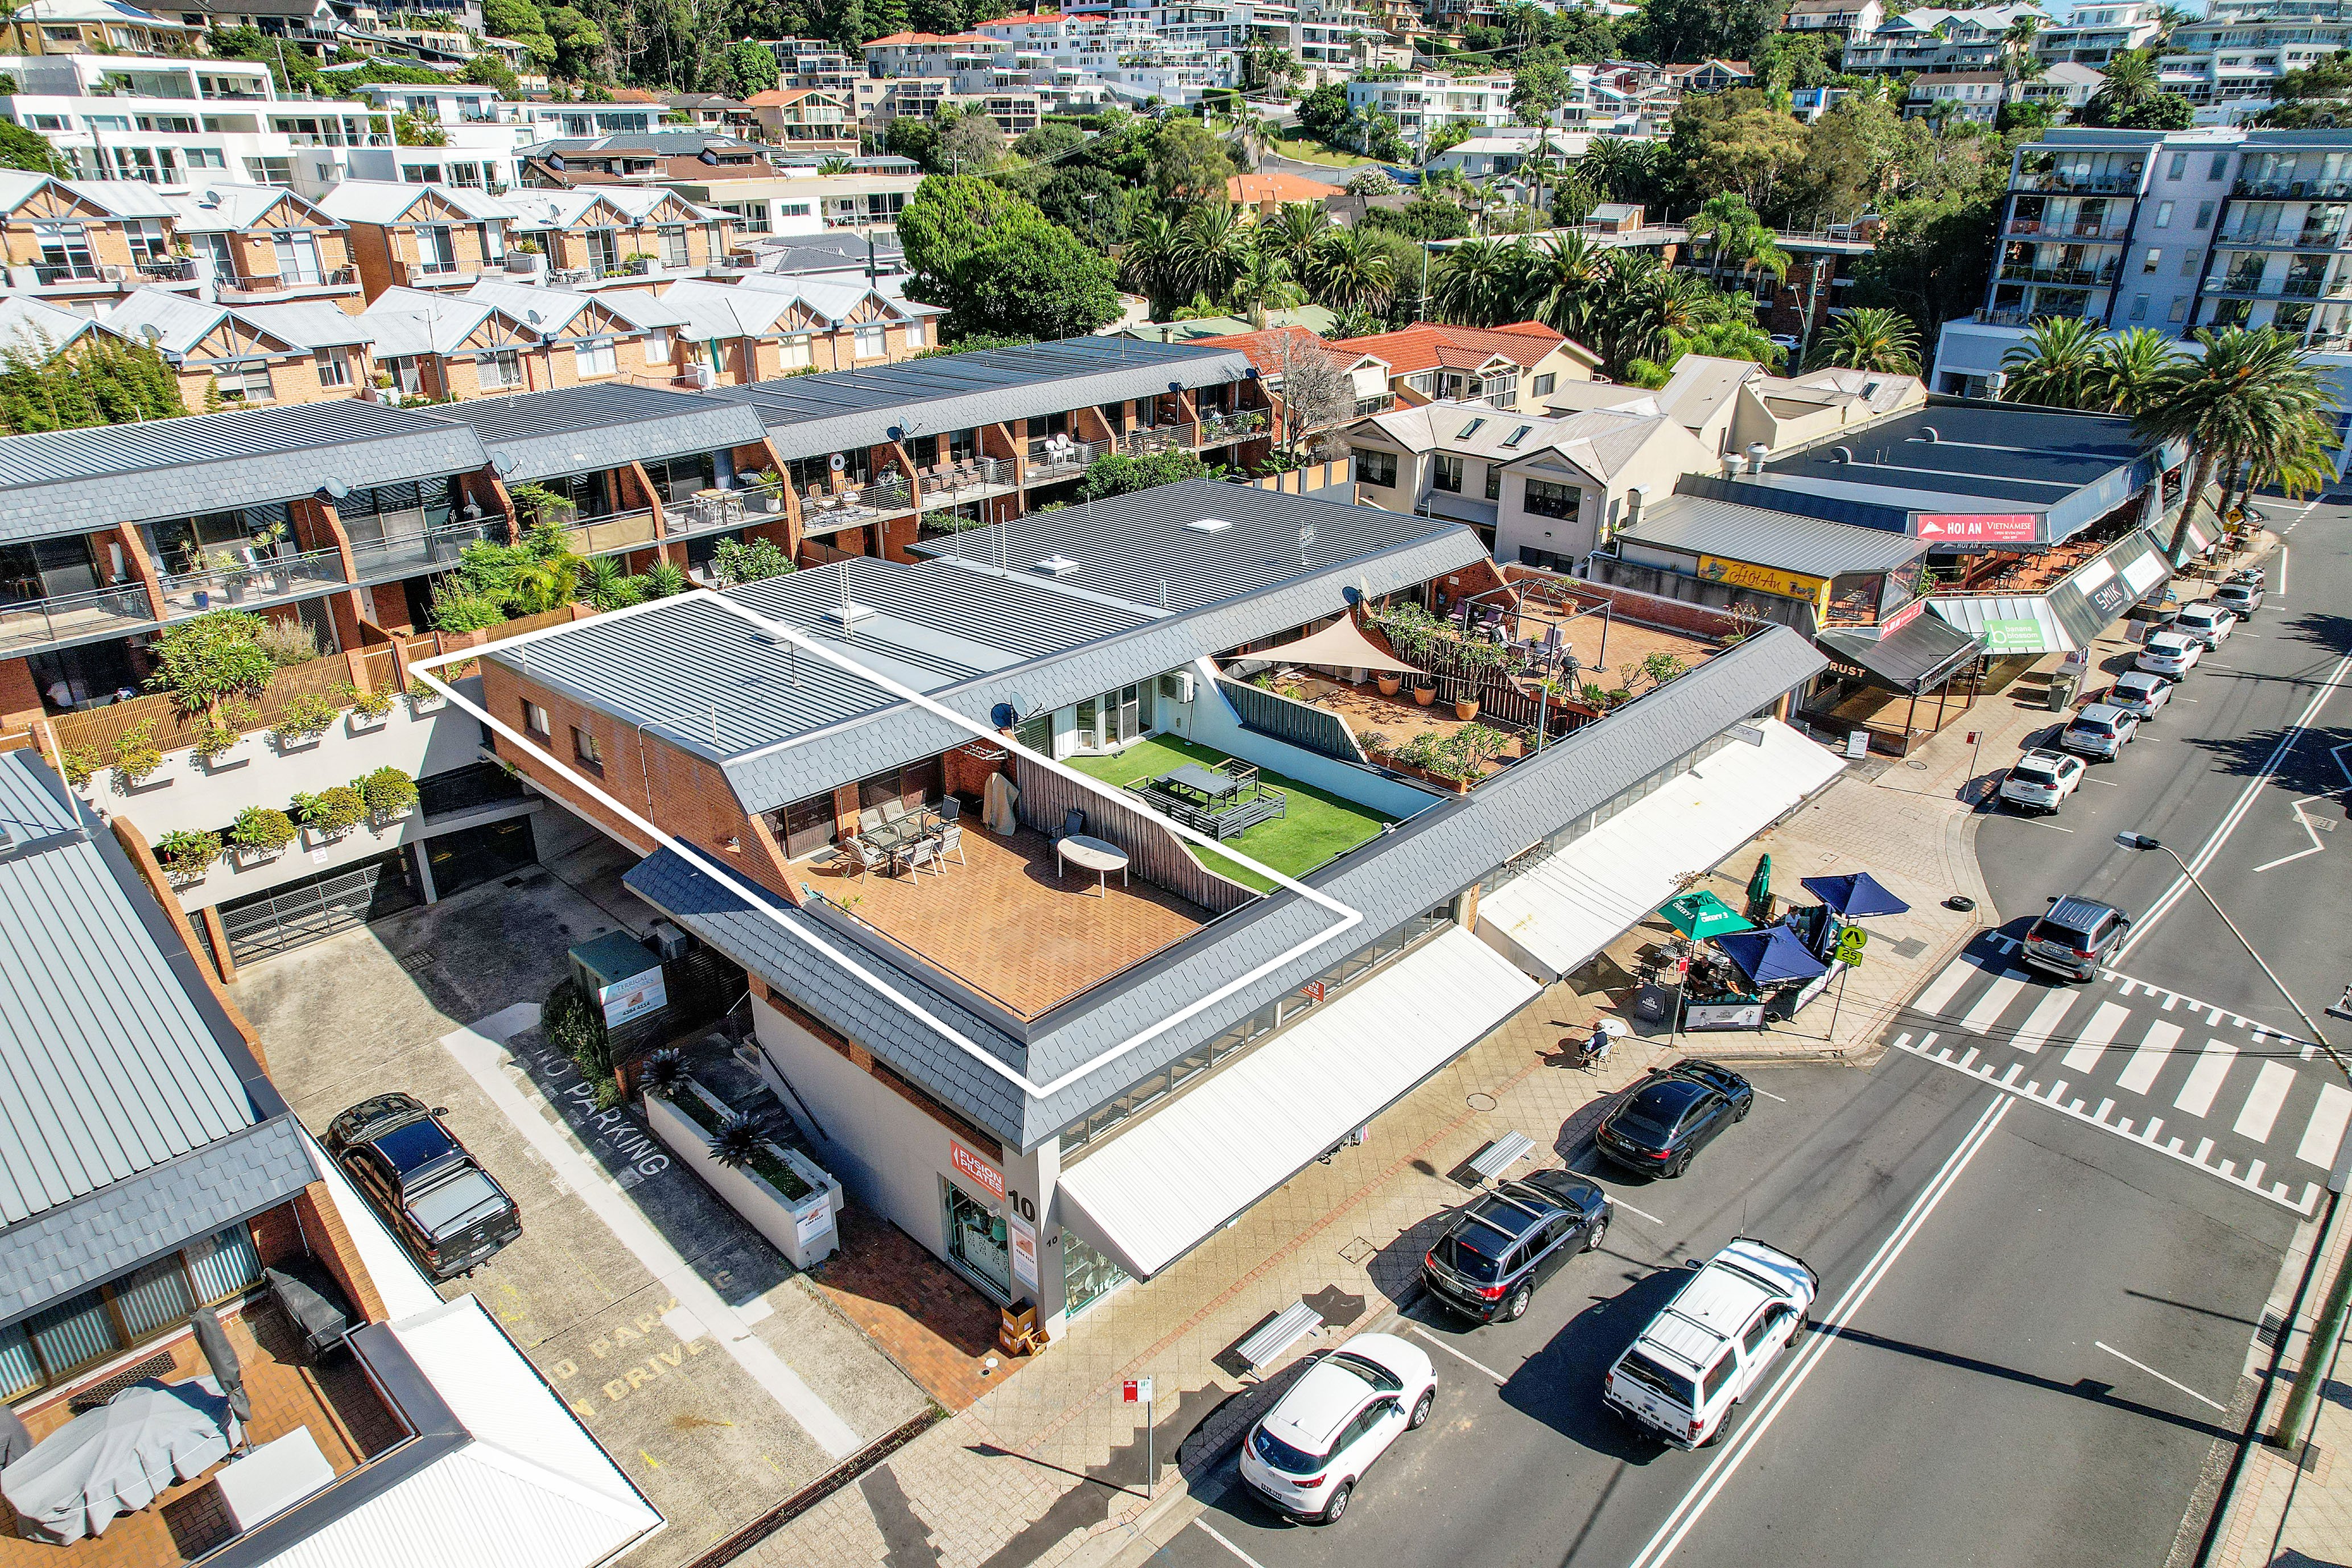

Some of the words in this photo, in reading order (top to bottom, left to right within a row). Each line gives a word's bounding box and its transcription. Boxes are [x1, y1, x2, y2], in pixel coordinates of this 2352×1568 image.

[1947, 522, 1965, 534] HOI
[1967, 522, 1982, 534] AN
[2094, 583, 2123, 610] SMIK
[1673, 902, 1690, 918] CHEEKY
[1701, 913, 1722, 922] CHEEKY
[1842, 950, 1857, 960] 25
[616, 975, 647, 991] TERRIGAL
[637, 1001, 650, 1010] 4114
[564, 1081, 670, 1175] PARKING
[960, 1149, 1002, 1185] FUSION
[961, 1159, 1002, 1192] PILATES
[958, 1187, 968, 1197] life
[1008, 1189, 1035, 1222] 10
[1047, 1236, 1058, 1248] 10
[963, 1258, 972, 1268] life
[973, 1267, 1004, 1292] emporium
[602, 1340, 707, 1402] DRIVE
